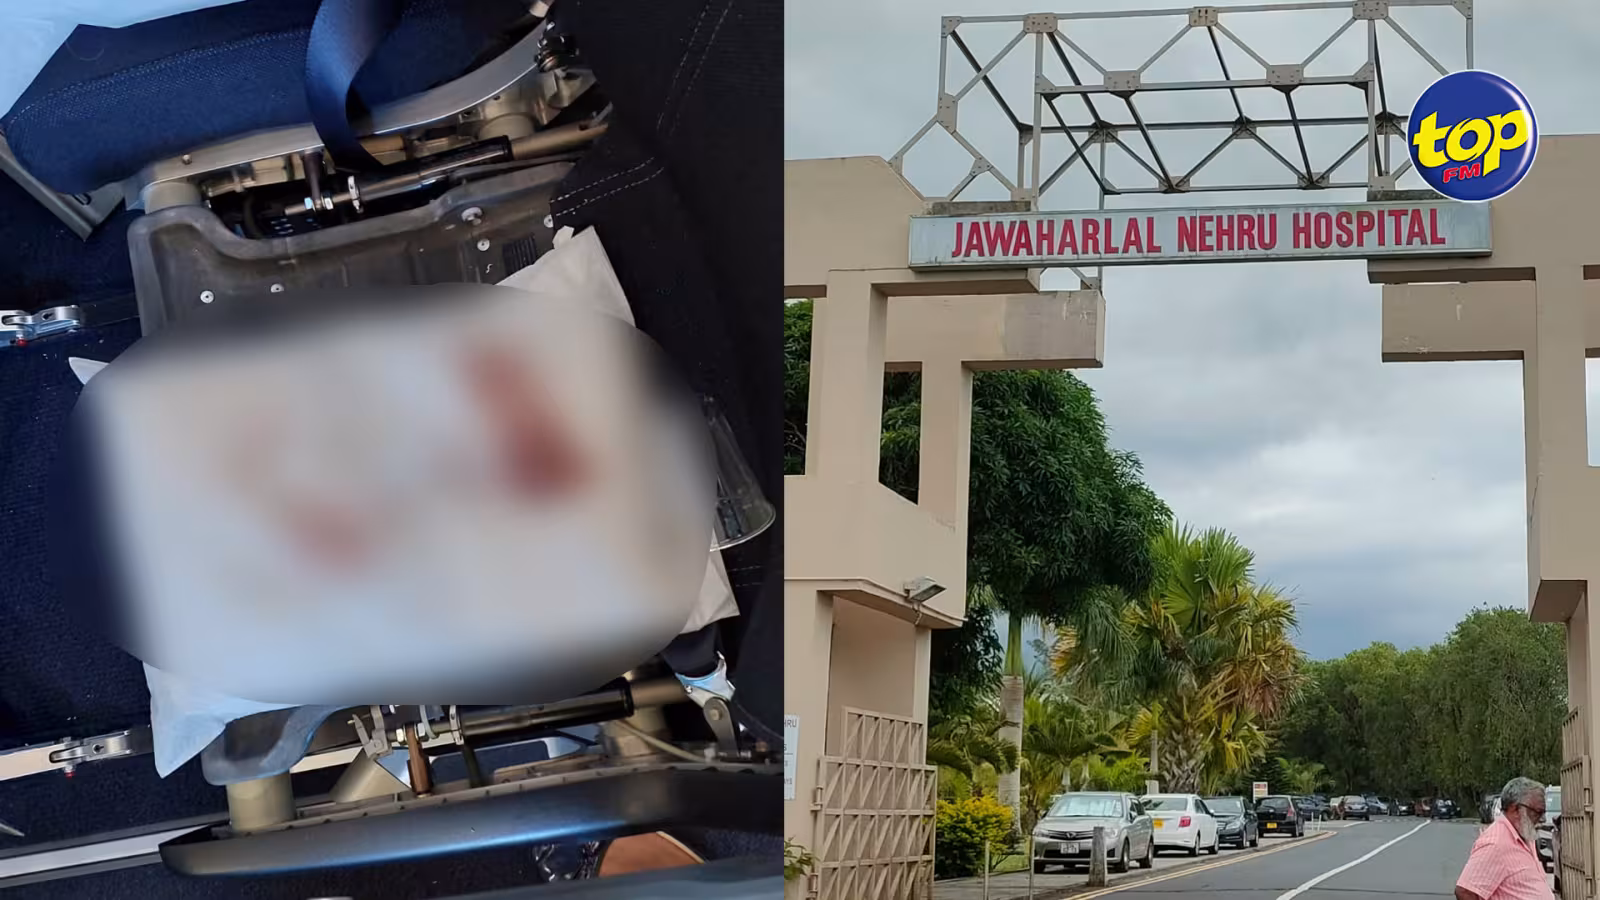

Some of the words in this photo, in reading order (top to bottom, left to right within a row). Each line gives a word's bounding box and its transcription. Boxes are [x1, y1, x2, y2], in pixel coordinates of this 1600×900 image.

[951, 217, 1161, 258] JAWAHARLAL
[1177, 213, 1277, 252] NEHRU
[1293, 208, 1446, 249] HOSPITAL
